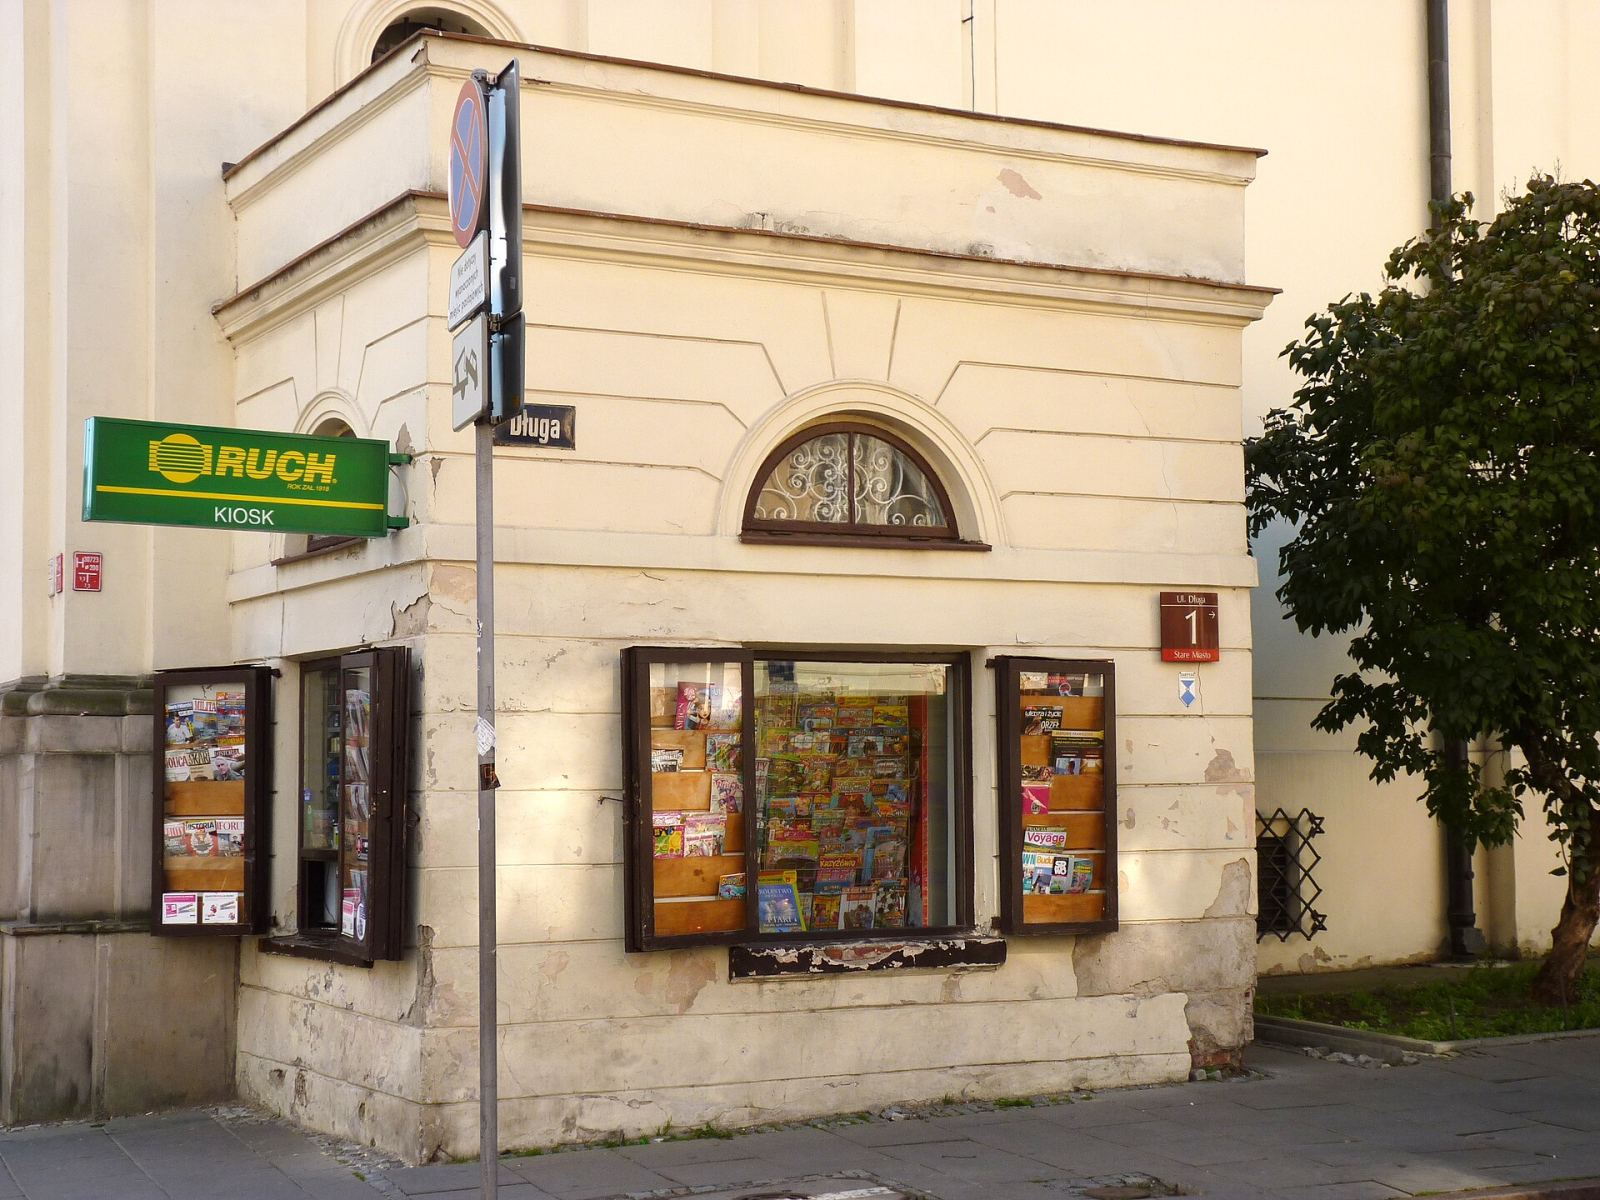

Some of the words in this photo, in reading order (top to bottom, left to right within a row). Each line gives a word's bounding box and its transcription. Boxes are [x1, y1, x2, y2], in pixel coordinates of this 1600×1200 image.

[215, 444, 337, 484] RUCH
[213, 506, 274, 525] KIOSK
[1188, 594, 1206, 605] Długa
[1184, 609, 1197, 645] 1
[1173, 650, 1190, 659] Stare
[1191, 651, 1212, 659] Miasto
[1027, 831, 1065, 845] Voyage
